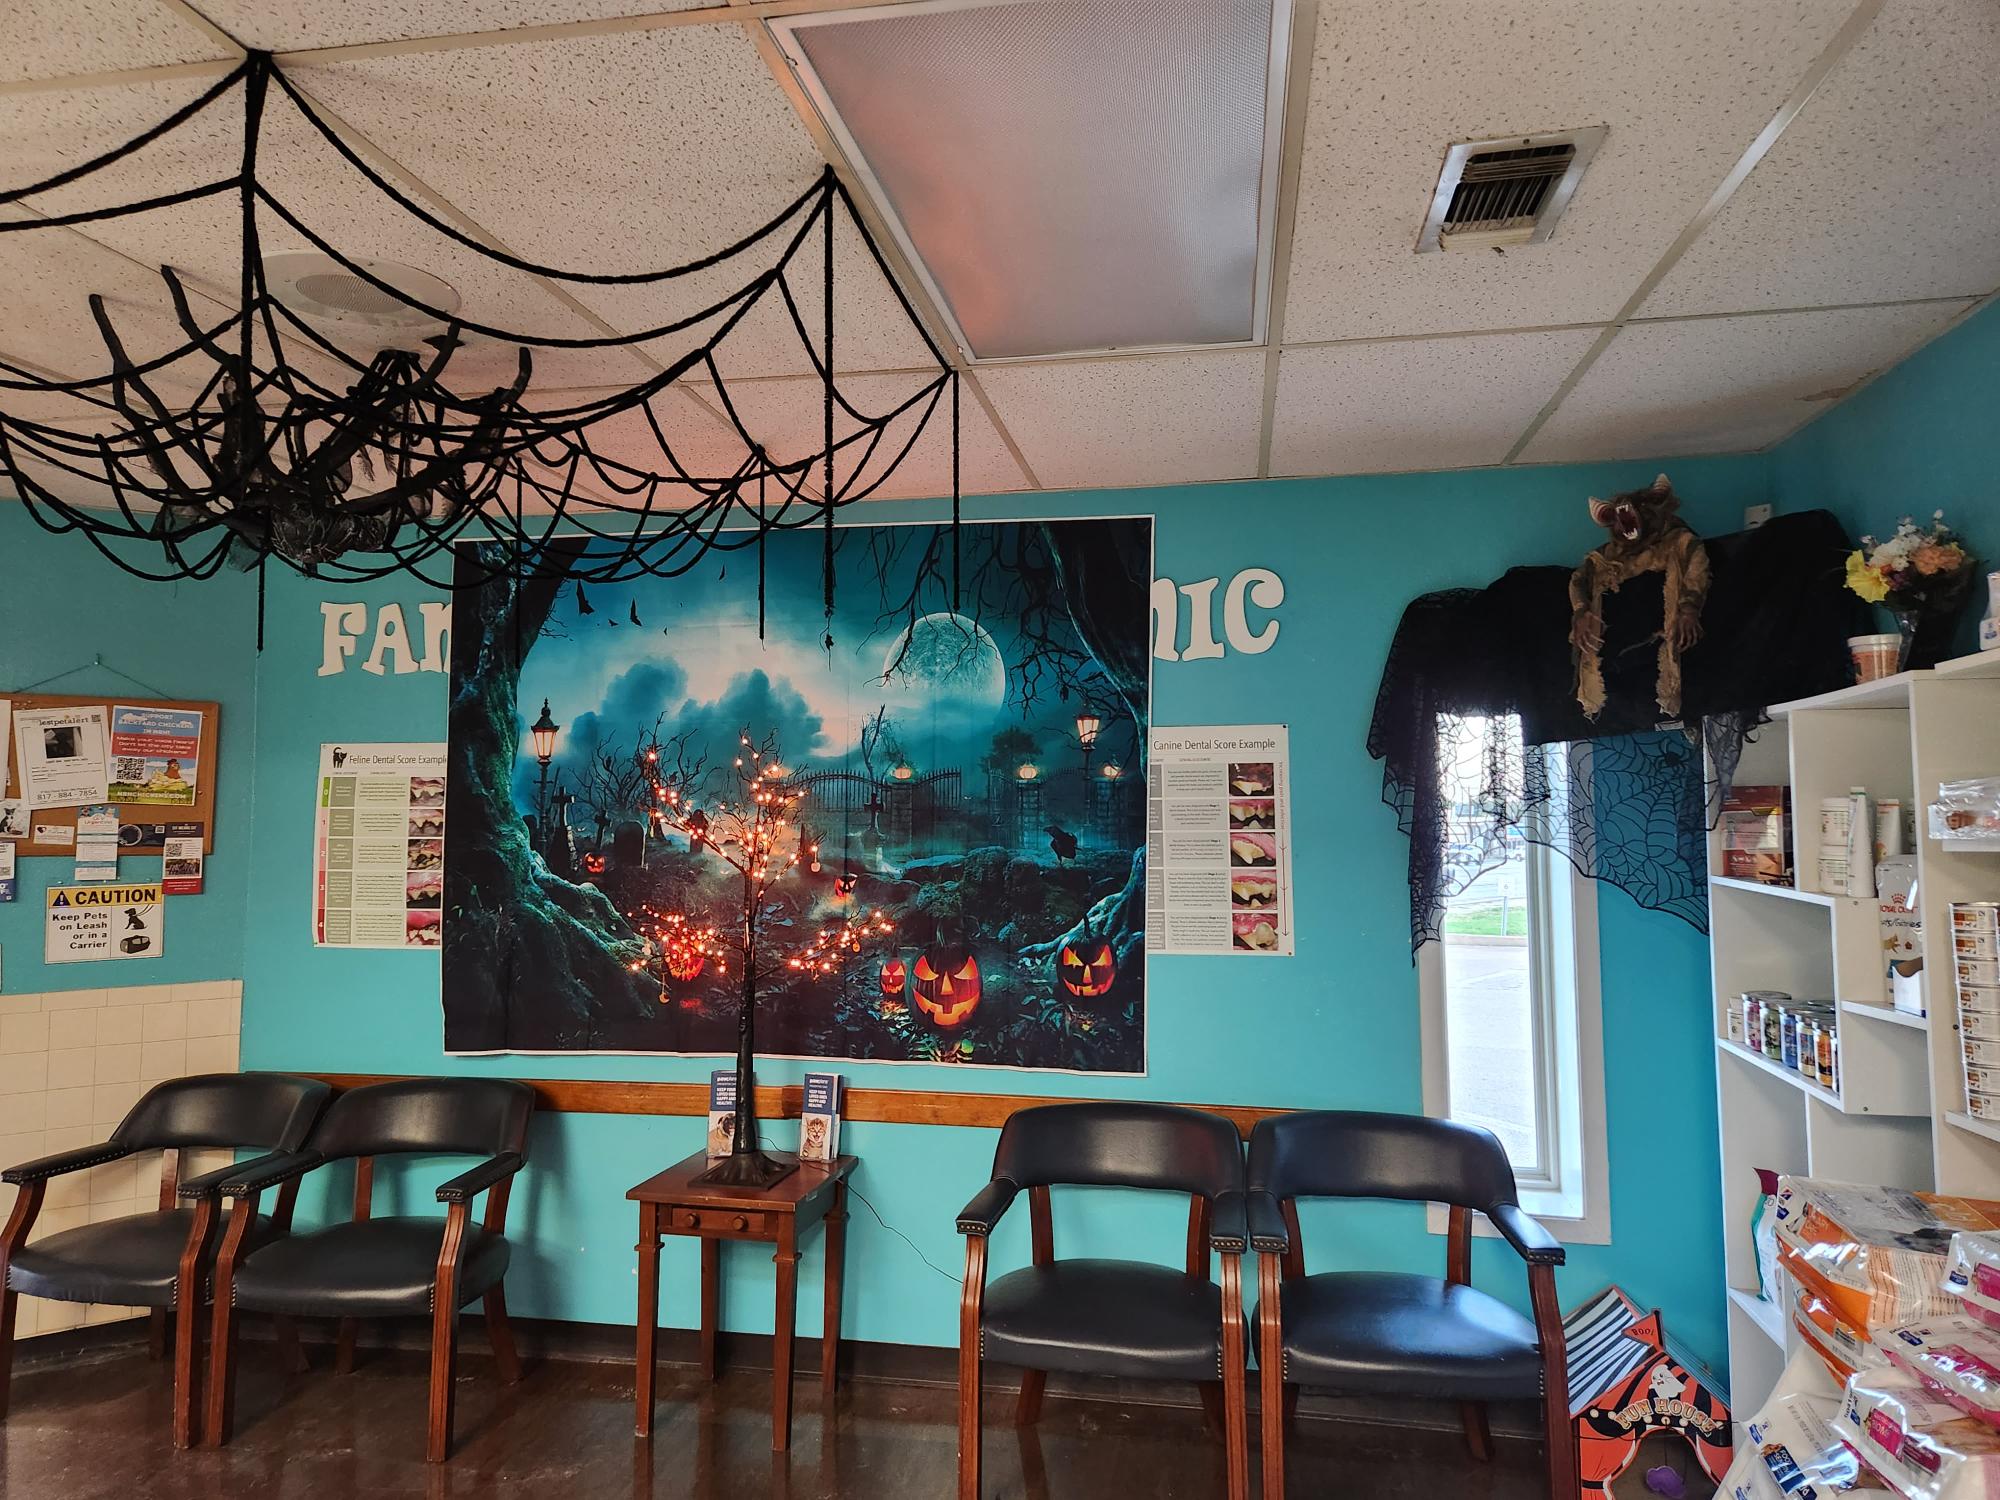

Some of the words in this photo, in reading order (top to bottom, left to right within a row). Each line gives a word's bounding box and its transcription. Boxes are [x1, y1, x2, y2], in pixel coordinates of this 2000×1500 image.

[1153, 740, 1182, 751] Canine
[1185, 739, 1212, 750] Dental
[1214, 739, 1237, 750] Score
[1239, 738, 1276, 751] Example
[349, 755, 370, 764] Feline
[373, 754, 396, 764] Dental
[397, 754, 416, 764] Score
[75, 888, 156, 905] CAUTION
[52, 914, 80, 922] Keep
[84, 912, 108, 920] Pets
[76, 922, 107, 930] Leash
[70, 941, 107, 949] Carrier
[1614, 1398, 1655, 1430] FUN
[1654, 1397, 1717, 1438] HOUSE
